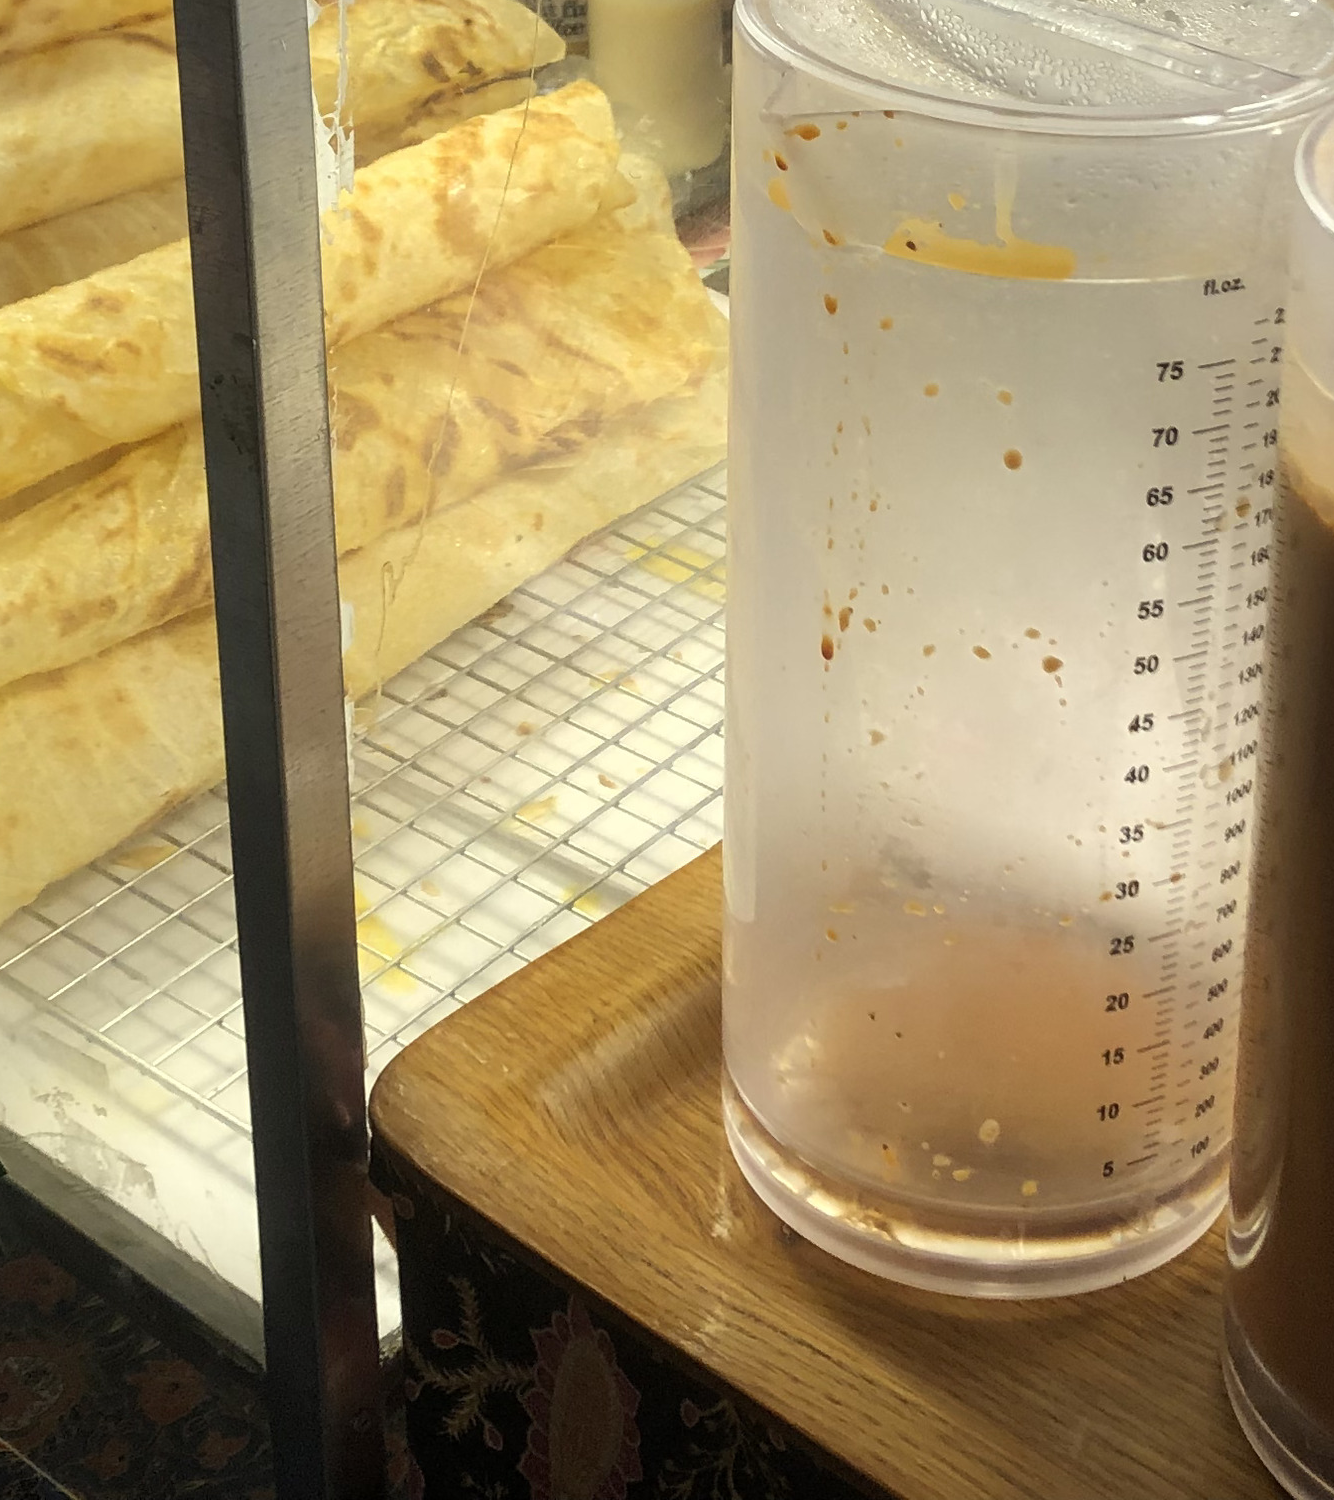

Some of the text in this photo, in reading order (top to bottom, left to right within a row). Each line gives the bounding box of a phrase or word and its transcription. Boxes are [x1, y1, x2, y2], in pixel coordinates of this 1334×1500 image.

[1156, 361, 1185, 383] 75
[1151, 426, 1179, 448] 70
[1146, 486, 1174, 507] 65
[1142, 542, 1169, 564] 60
[1137, 600, 1165, 621] 55
[1133, 655, 1160, 676] 50
[1128, 713, 1155, 734] 45
[1124, 764, 1150, 785] 40
[1118, 824, 1145, 845] 35
[1115, 879, 1140, 900] 30
[1216, 898, 1237, 923] 700
[1109, 935, 1135, 956] 25
[1105, 992, 1130, 1013] 20
[1101, 1047, 1125, 1067] 15
[1096, 1102, 1120, 1122] 10
[1190, 1135, 1210, 1158] 100
[1102, 1160, 1115, 1178] 5
